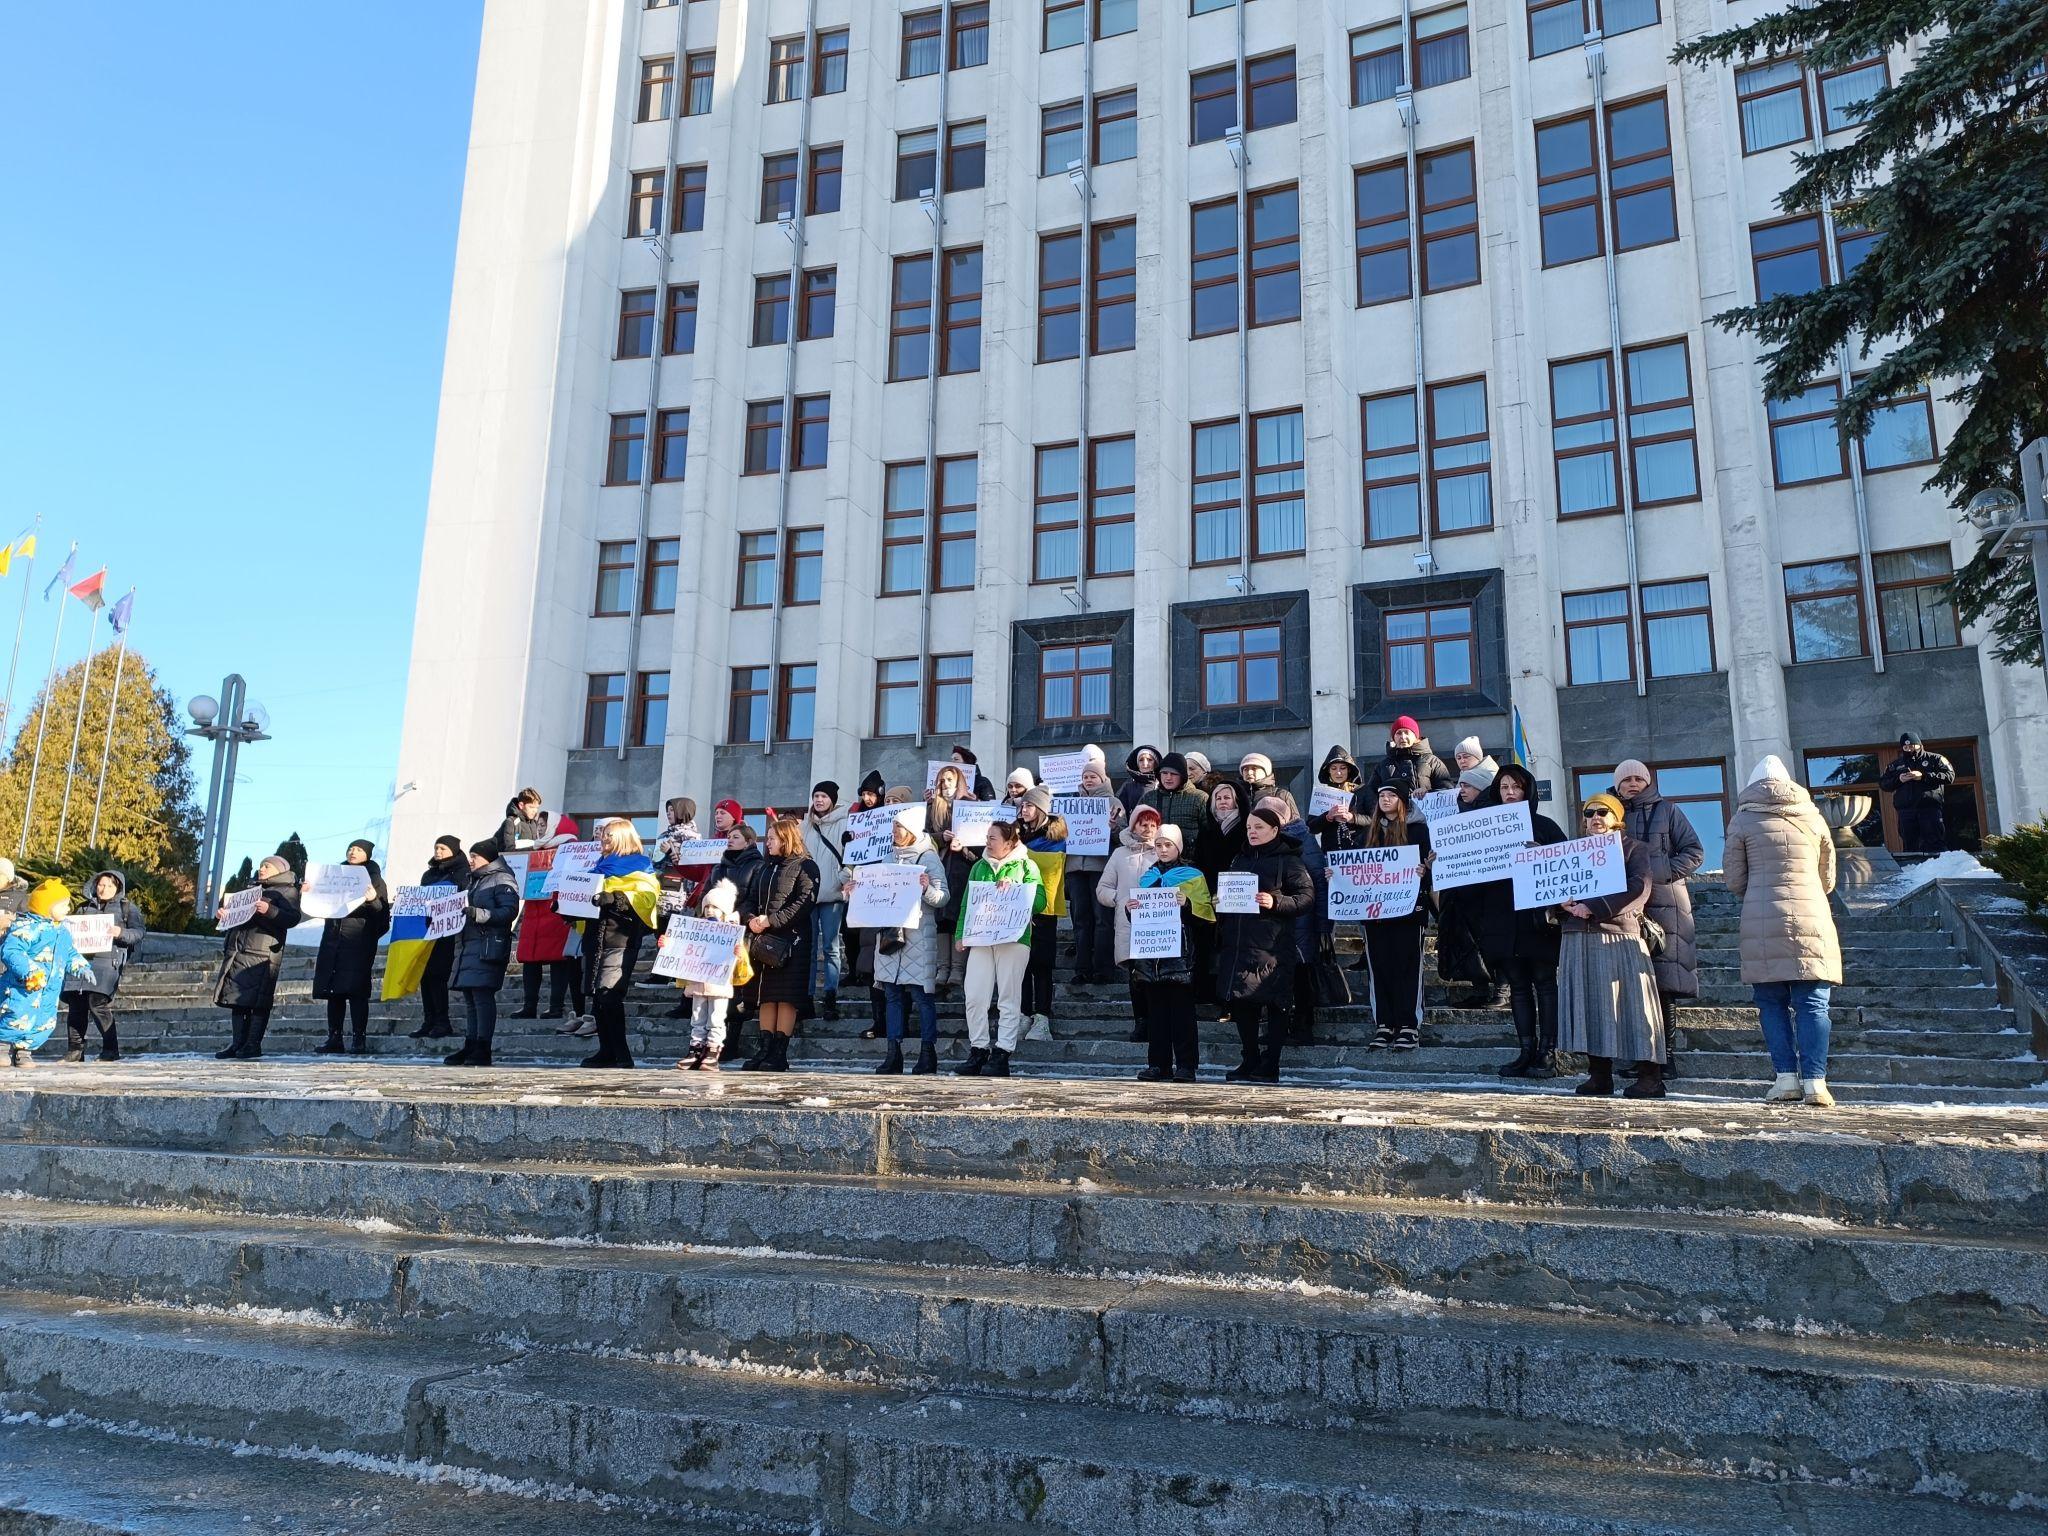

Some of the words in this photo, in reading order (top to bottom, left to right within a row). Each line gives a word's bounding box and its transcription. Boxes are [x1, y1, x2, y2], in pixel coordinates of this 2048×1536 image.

[849, 810, 873, 826] 704
[1437, 817, 1492, 836] ВІЙСЬКОВІ
[1494, 812, 1519, 824] ТЕЖ
[1435, 822, 1524, 848] ВТОМЛЮЮТЬСЯ!
[850, 849, 869, 862] ЧАС
[1330, 848, 1399, 866] ВИМАГАЄМО
[1438, 849, 1483, 863] вимагаємо
[1484, 840, 1525, 857] розумних
[1515, 833, 1616, 864] ДЕМОБІЛІЗАЦІЯ
[1339, 863, 1383, 876] ТЕРМІНІВ
[1435, 873, 1444, 881] 24
[1445, 868, 1471, 879] місяці
[1477, 863, 1507, 875] крайня
[1446, 859, 1481, 870] термінів
[1533, 856, 1580, 876] ПІСЛЯ
[1588, 850, 1606, 867] 18
[1535, 869, 1593, 889] МІСЯЦІВ
[1137, 892, 1151, 901] МІЙ
[1153, 892, 1174, 900] ТАТО
[1330, 887, 1412, 905] Демобілізація
[1152, 909, 1173, 918] ВІЙНІ
[1334, 908, 1360, 916] після
[1366, 902, 1382, 918] 18
[674, 917, 687, 929] ЗА
[691, 920, 740, 936] ПЕРЕМОГУ
[1134, 928, 1177, 937] ПОВЕРНІТЬ
[666, 928, 738, 946] ВІДПОВІДАЛЬНІ
[1158, 936, 1177, 944] ТАТА
[685, 943, 707, 958] ВСІ
[1138, 944, 1172, 954] ДОДОМУ
[654, 954, 680, 971] ПОРА
[680, 959, 729, 978] МІНЯТИСЯ
